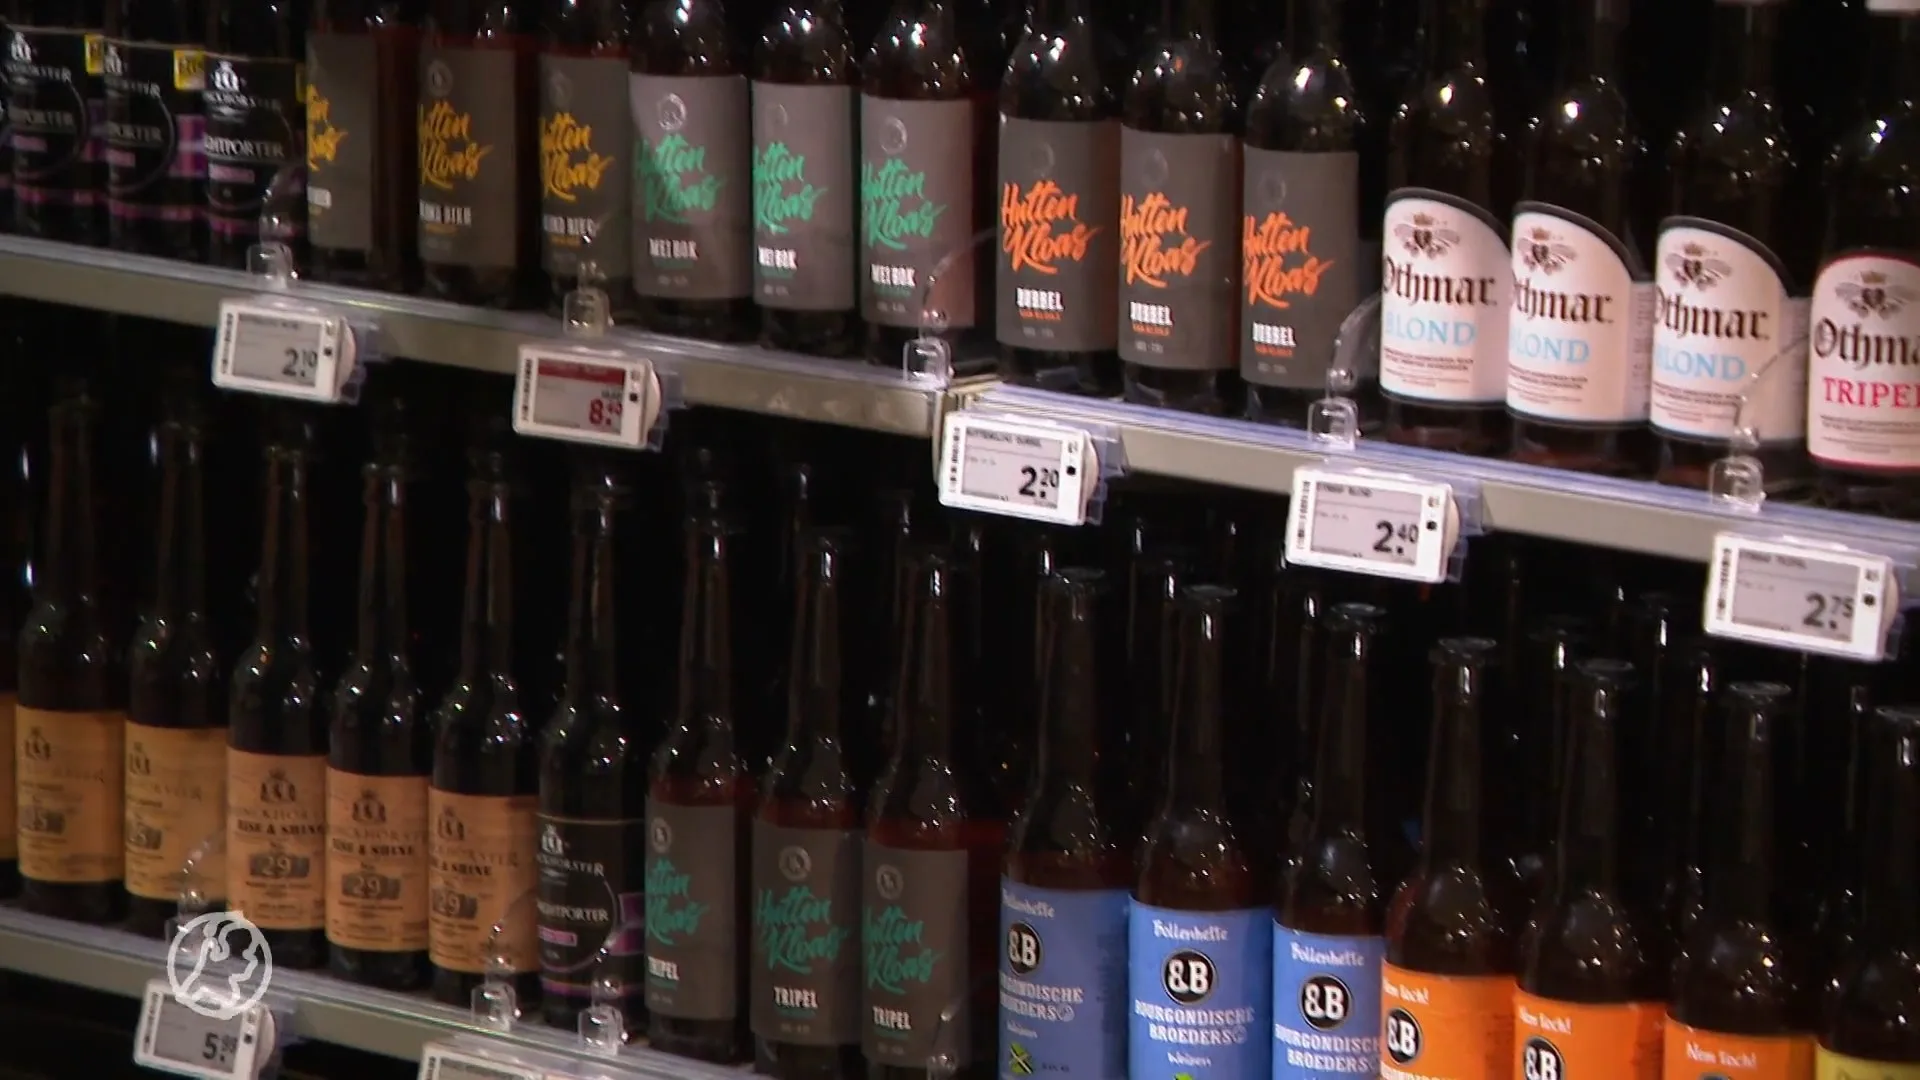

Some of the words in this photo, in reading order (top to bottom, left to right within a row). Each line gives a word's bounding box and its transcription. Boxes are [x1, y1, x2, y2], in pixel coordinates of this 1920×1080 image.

[261, 851, 291, 875] 29
[350, 871, 381, 897] 29
[773, 986, 818, 1009] TRIPEL
[872, 1005, 912, 1031] TRIPEL
